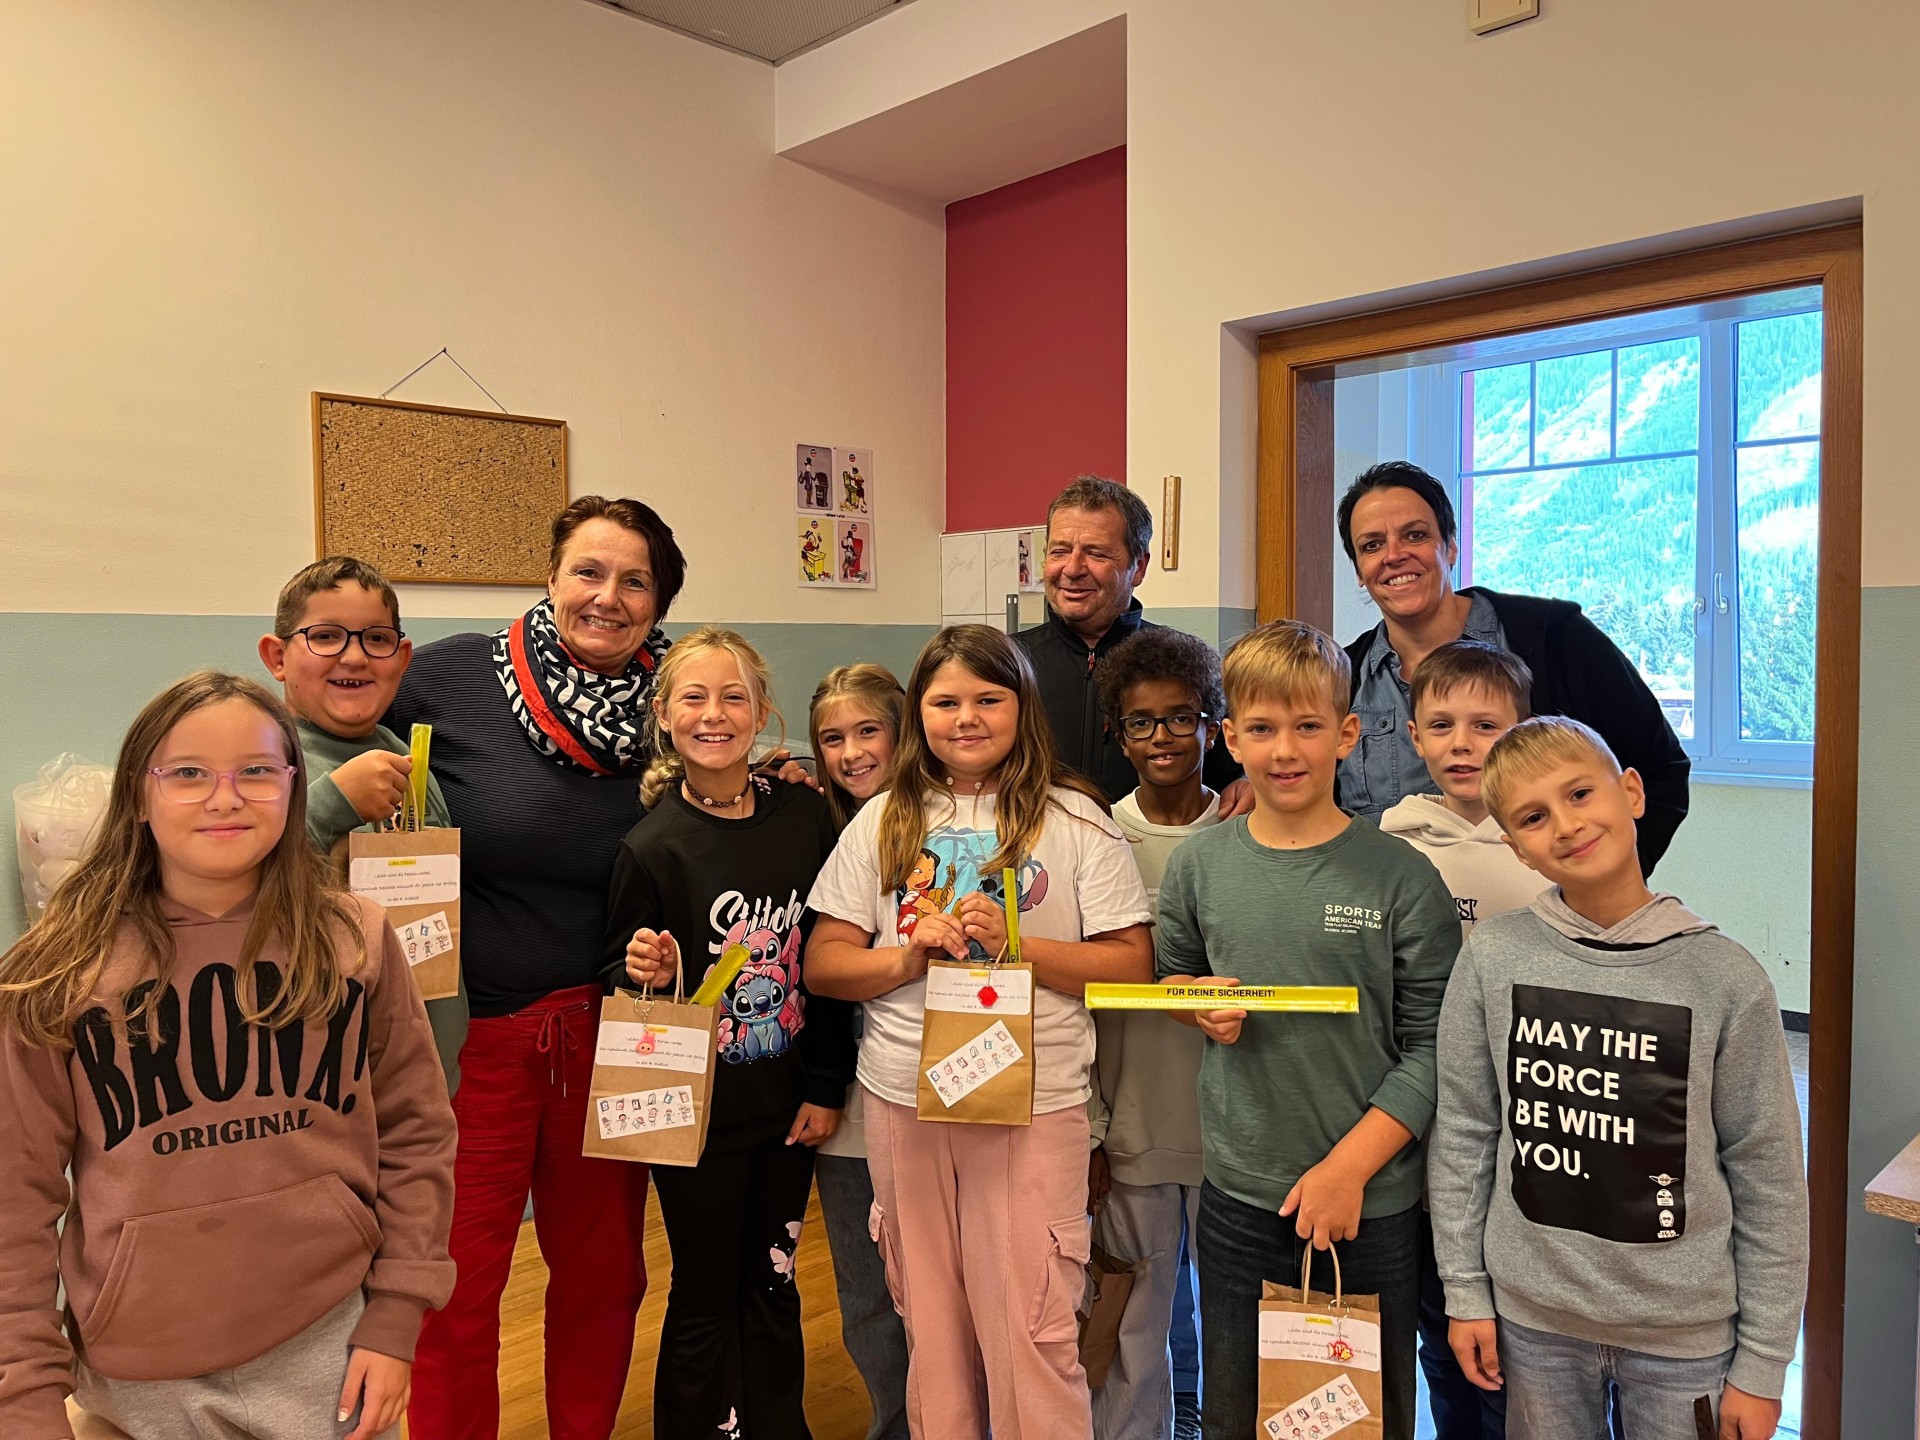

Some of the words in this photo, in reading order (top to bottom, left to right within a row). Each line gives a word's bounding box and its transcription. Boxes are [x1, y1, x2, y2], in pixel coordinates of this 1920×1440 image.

[708, 889, 807, 954] Stitch
[1324, 904, 1381, 921] SPORTS
[1324, 915, 1363, 926] AMERICAN
[1167, 988, 1185, 997] FÜR
[1188, 988, 1215, 997] DEINE
[1218, 989, 1276, 998] SICHERHEIT!
[73, 961, 370, 1152] BRONX!
[1515, 1016, 1592, 1052] MAY
[1600, 1027, 1658, 1062] THE
[1515, 1056, 1620, 1101] FORCE
[152, 1108, 315, 1155] ORIGINAL
[1515, 1098, 1549, 1129] BE
[1557, 1105, 1635, 1145] WITH
[1515, 1138, 1590, 1180] YOU.
